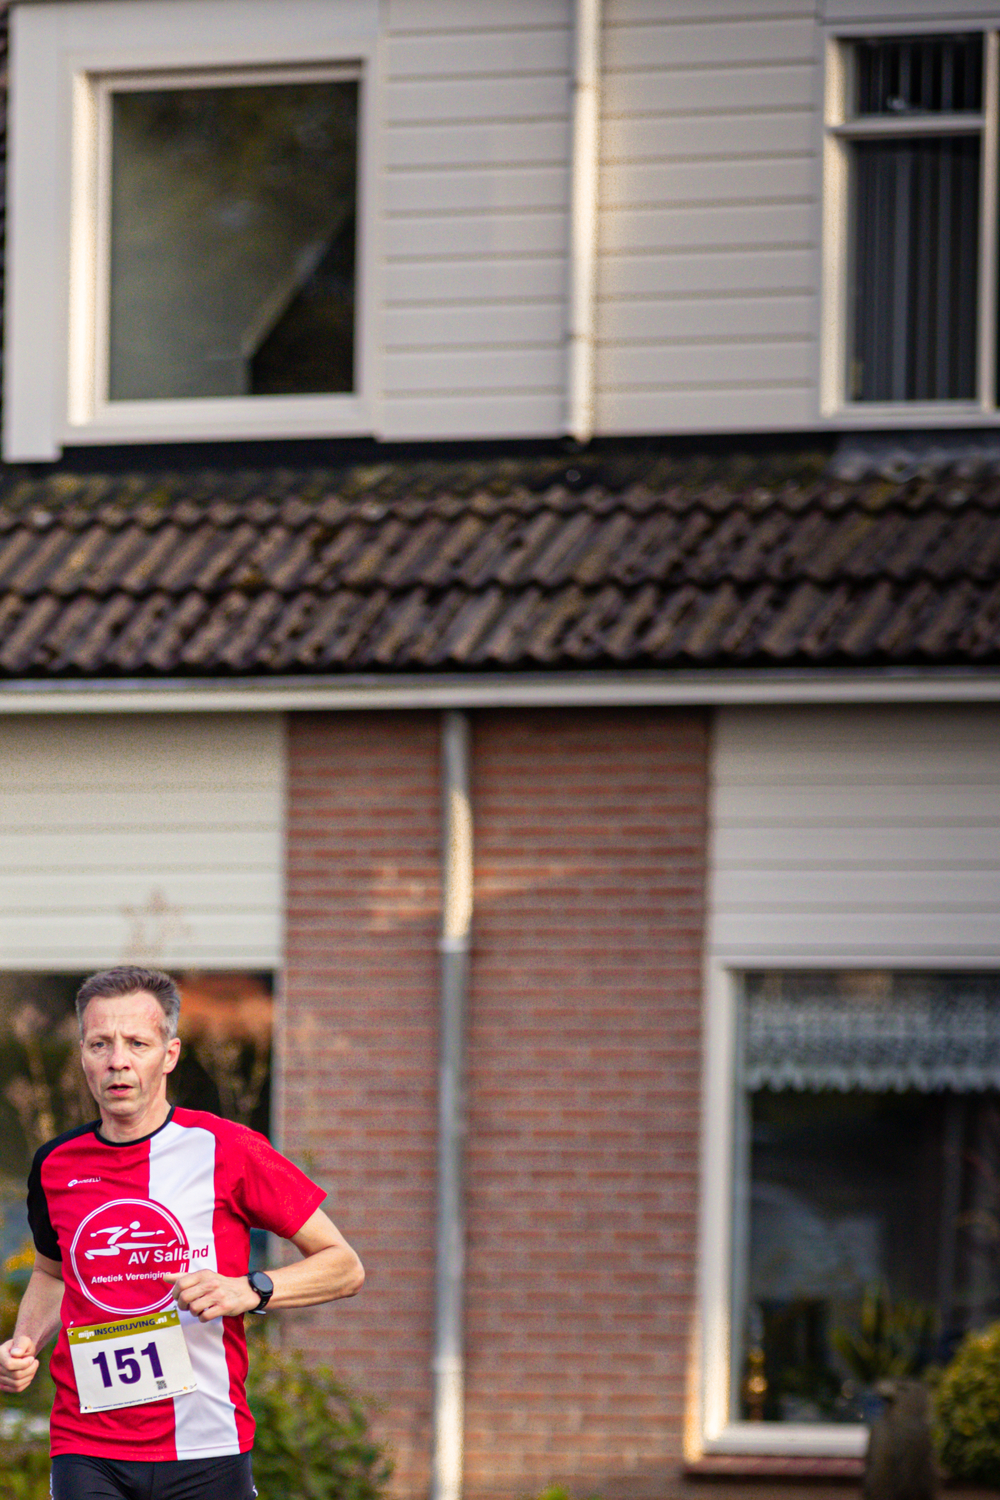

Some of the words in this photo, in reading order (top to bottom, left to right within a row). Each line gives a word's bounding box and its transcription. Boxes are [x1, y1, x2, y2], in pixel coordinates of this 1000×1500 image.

[128, 1250, 150, 1265] AV
[153, 1245, 209, 1263] Salland
[91, 1273, 123, 1285] Atletiek
[125, 1271, 171, 1281] Verenigin
[92, 1341, 164, 1389] 151
